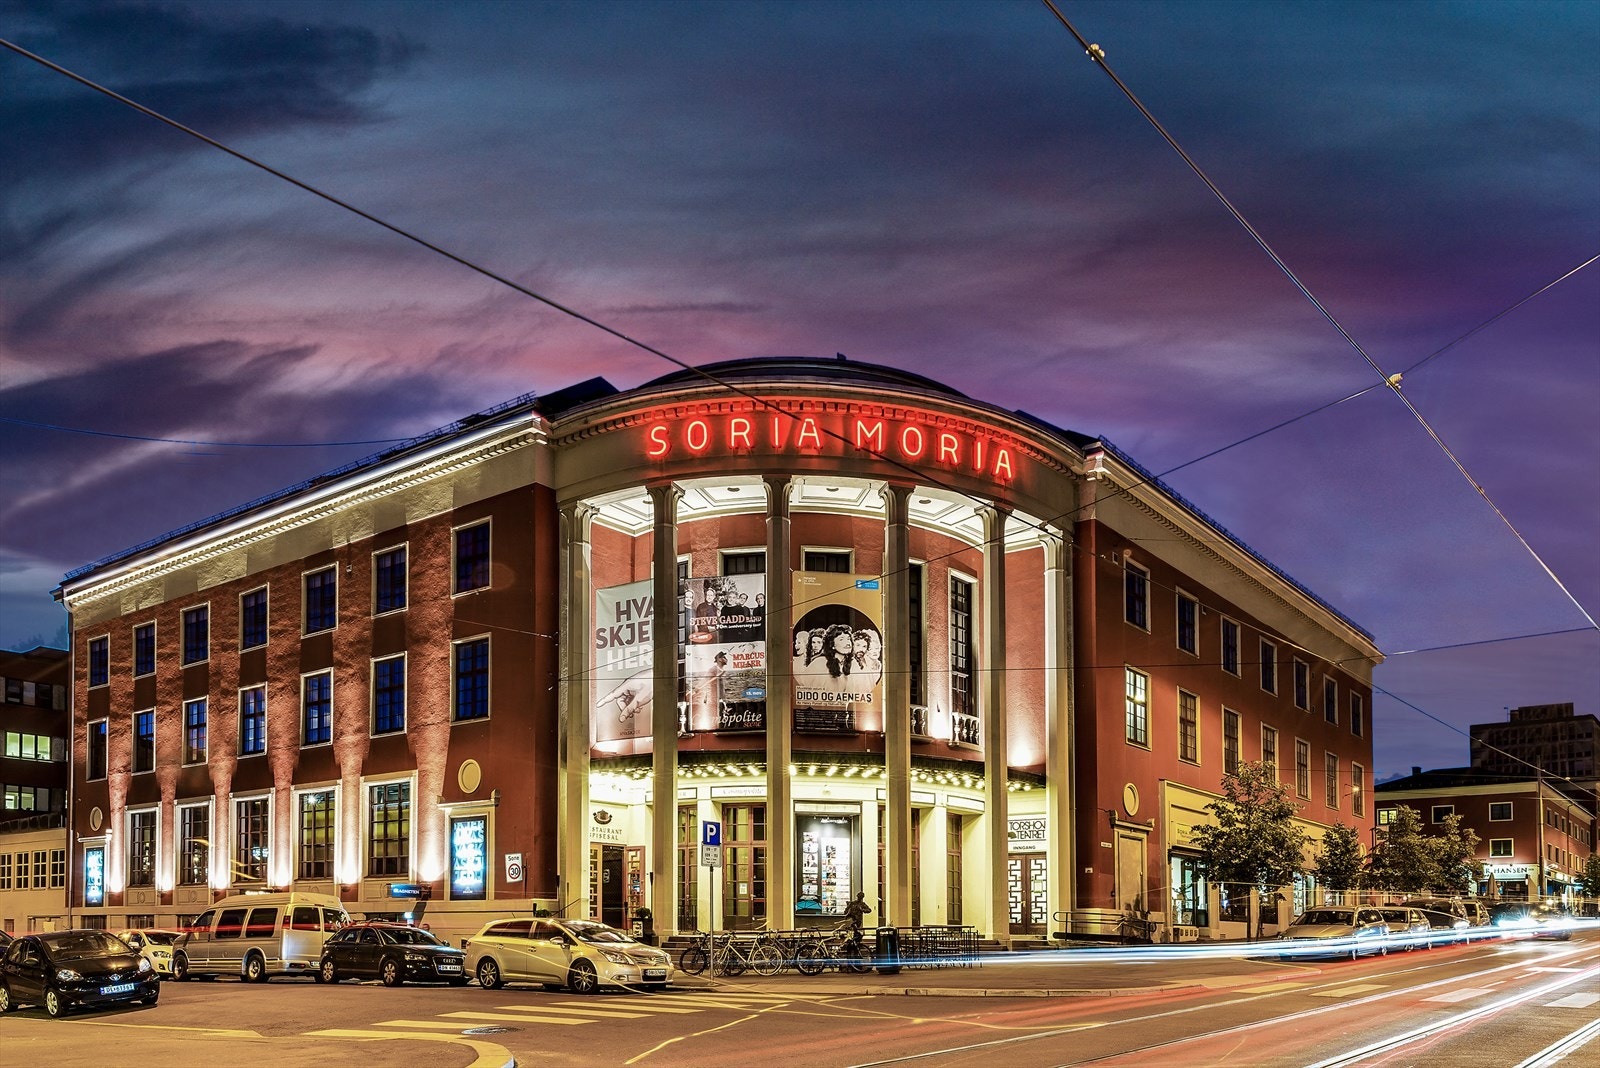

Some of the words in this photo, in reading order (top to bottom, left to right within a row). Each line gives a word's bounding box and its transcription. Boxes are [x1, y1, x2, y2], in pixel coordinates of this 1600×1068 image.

[649, 417, 822, 456] SORIA
[856, 419, 1014, 480] MORIA
[690, 616, 718, 626] STEVE
[719, 615, 745, 625] GADD
[732, 651, 765, 661] MARCUS
[732, 660, 762, 669] MILLER
[797, 691, 819, 701] DIDO
[821, 691, 834, 702] OG
[836, 692, 872, 703] AENEAS
[706, 824, 717, 843] P
[1016, 829, 1046, 839] TEATRET
[510, 867, 519, 876] 30
